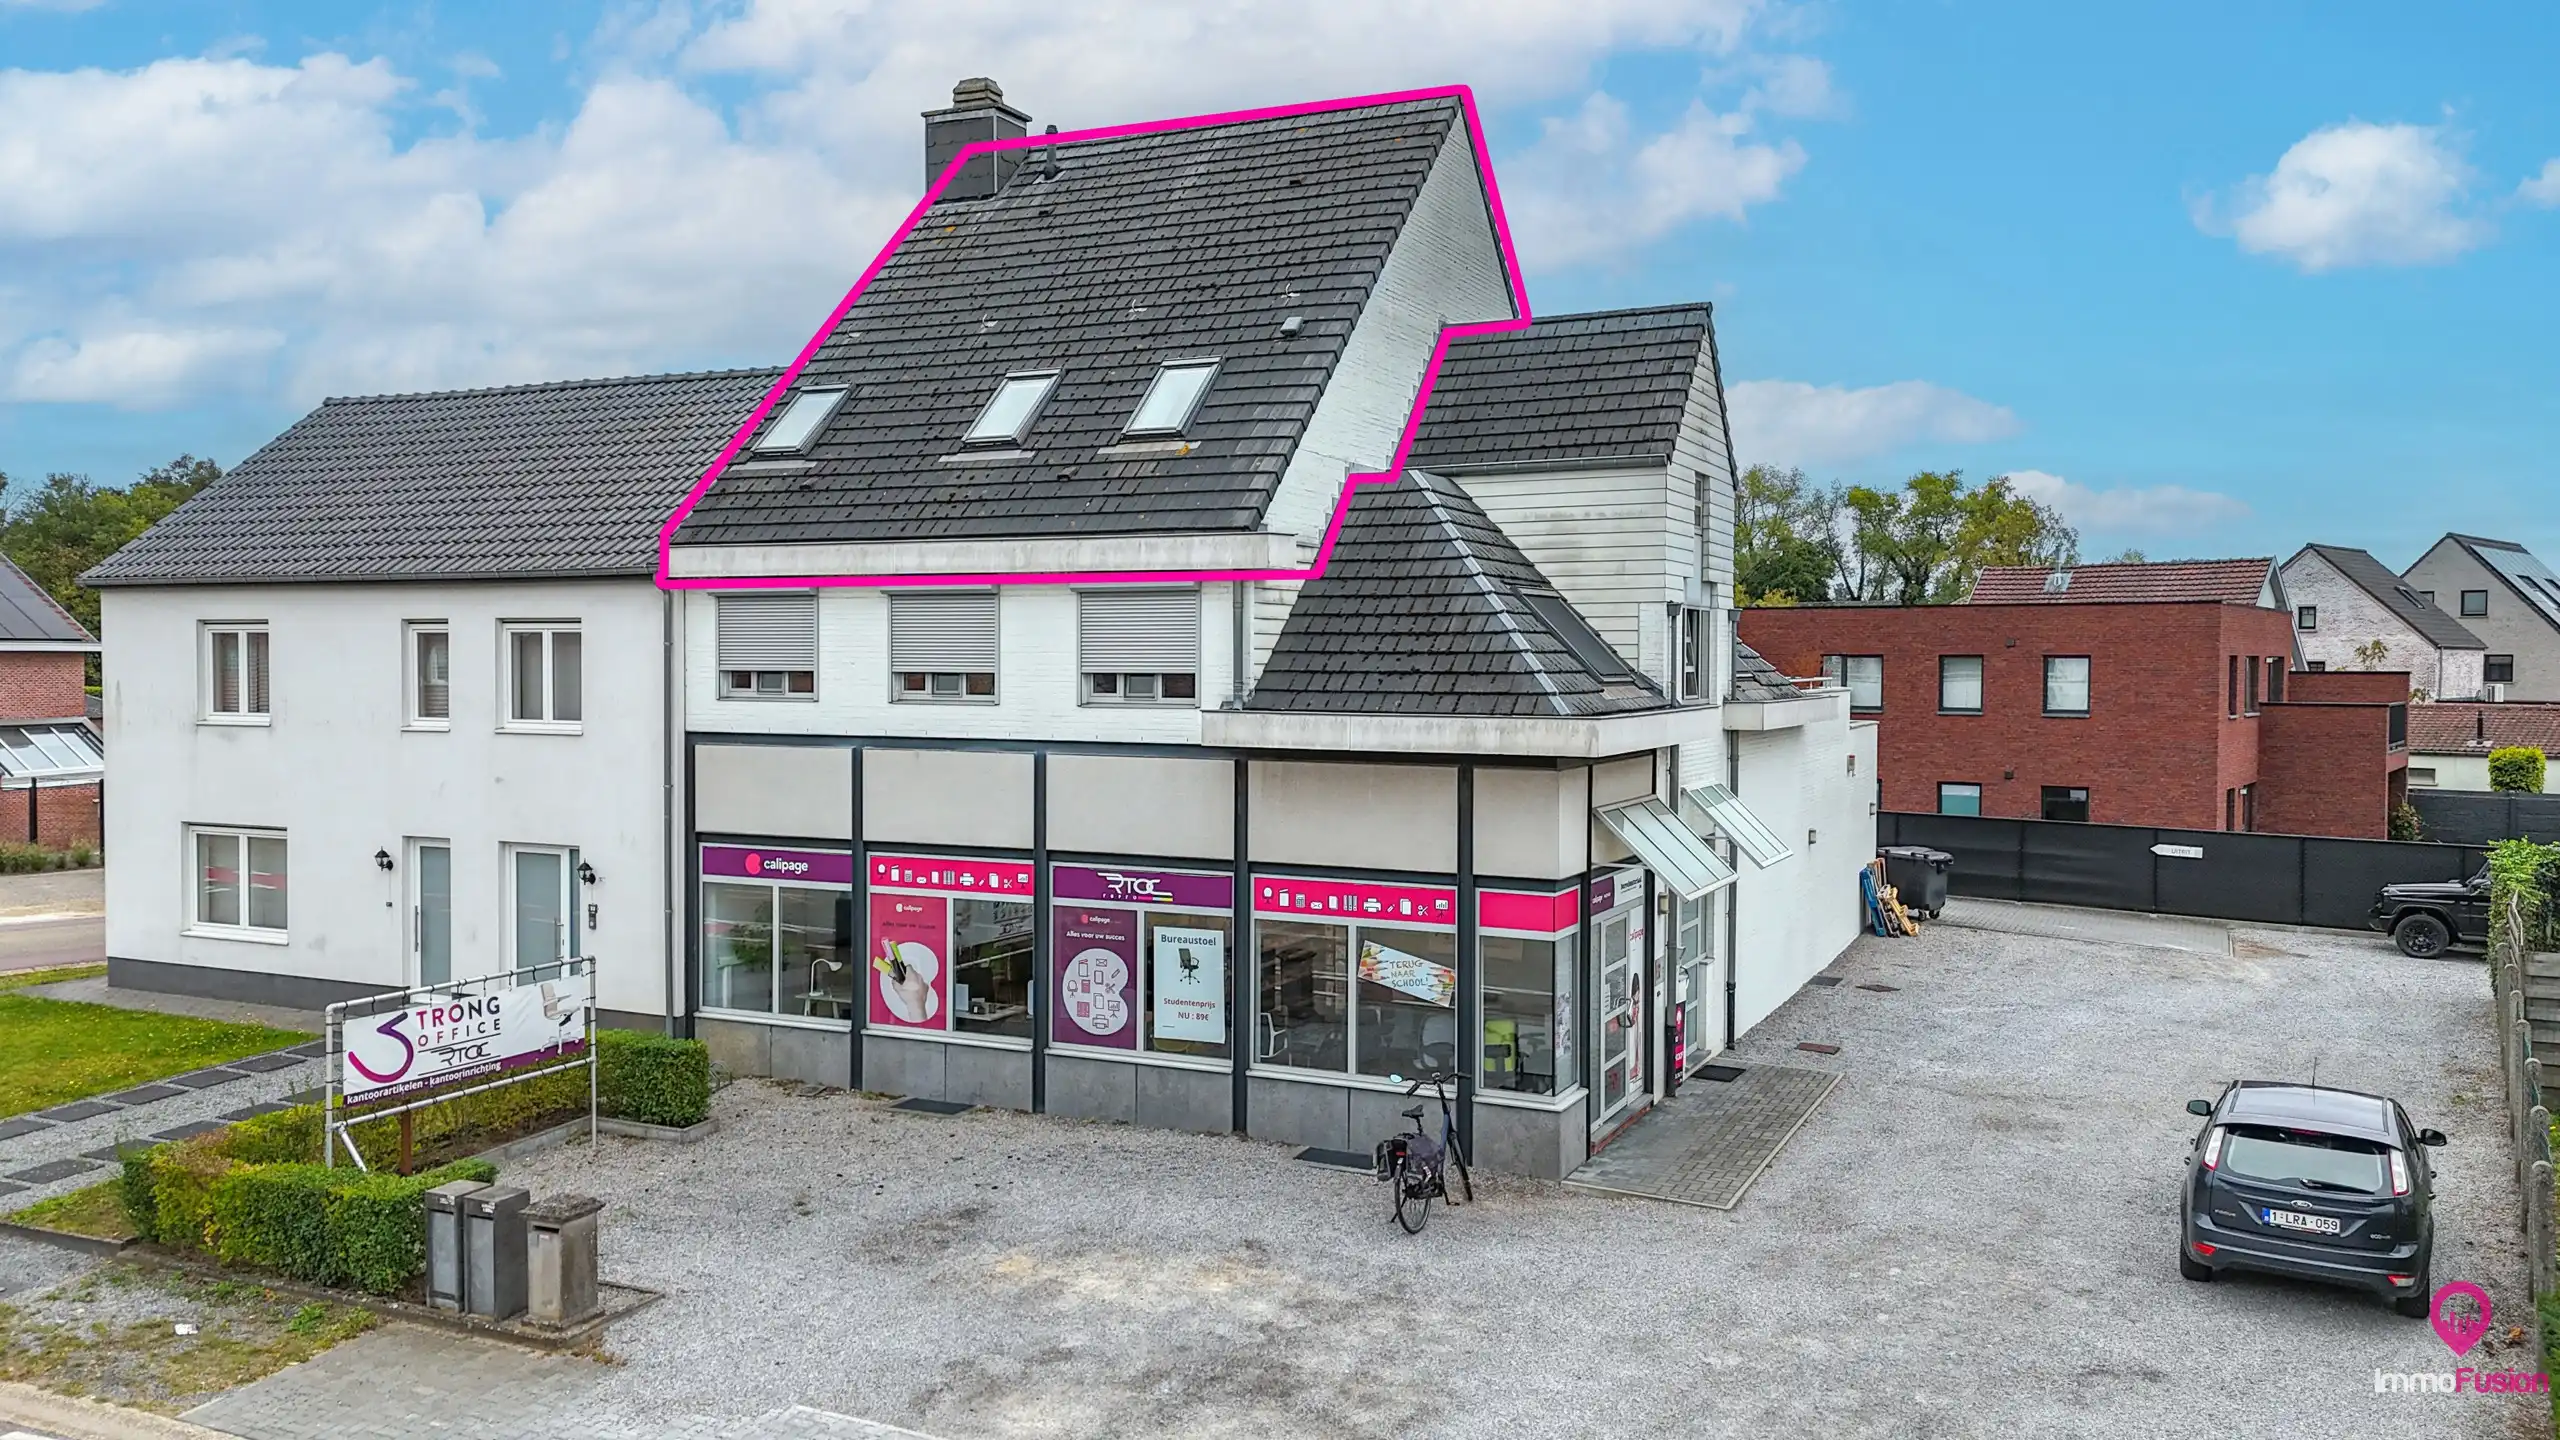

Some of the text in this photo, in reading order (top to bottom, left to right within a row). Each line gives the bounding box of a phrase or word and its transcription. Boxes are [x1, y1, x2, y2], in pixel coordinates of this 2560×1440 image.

[763, 857, 809, 875] calipage
[1089, 916, 1111, 924] calipage
[1066, 930, 1081, 938] Alles
[1161, 934, 1216, 946] Bureaustoel
[1390, 960, 1424, 969] TERUG
[1391, 970, 1416, 978] NAAR
[1163, 998, 1216, 1009] Studentenprijs
[1178, 1012, 1190, 1020] NU
[1195, 1013, 1209, 1021] 89€
[417, 1018, 501, 1047] OFFICE
[347, 1080, 423, 1105] kantoorartikelen
[429, 1061, 502, 1088] kantoorinrichting
